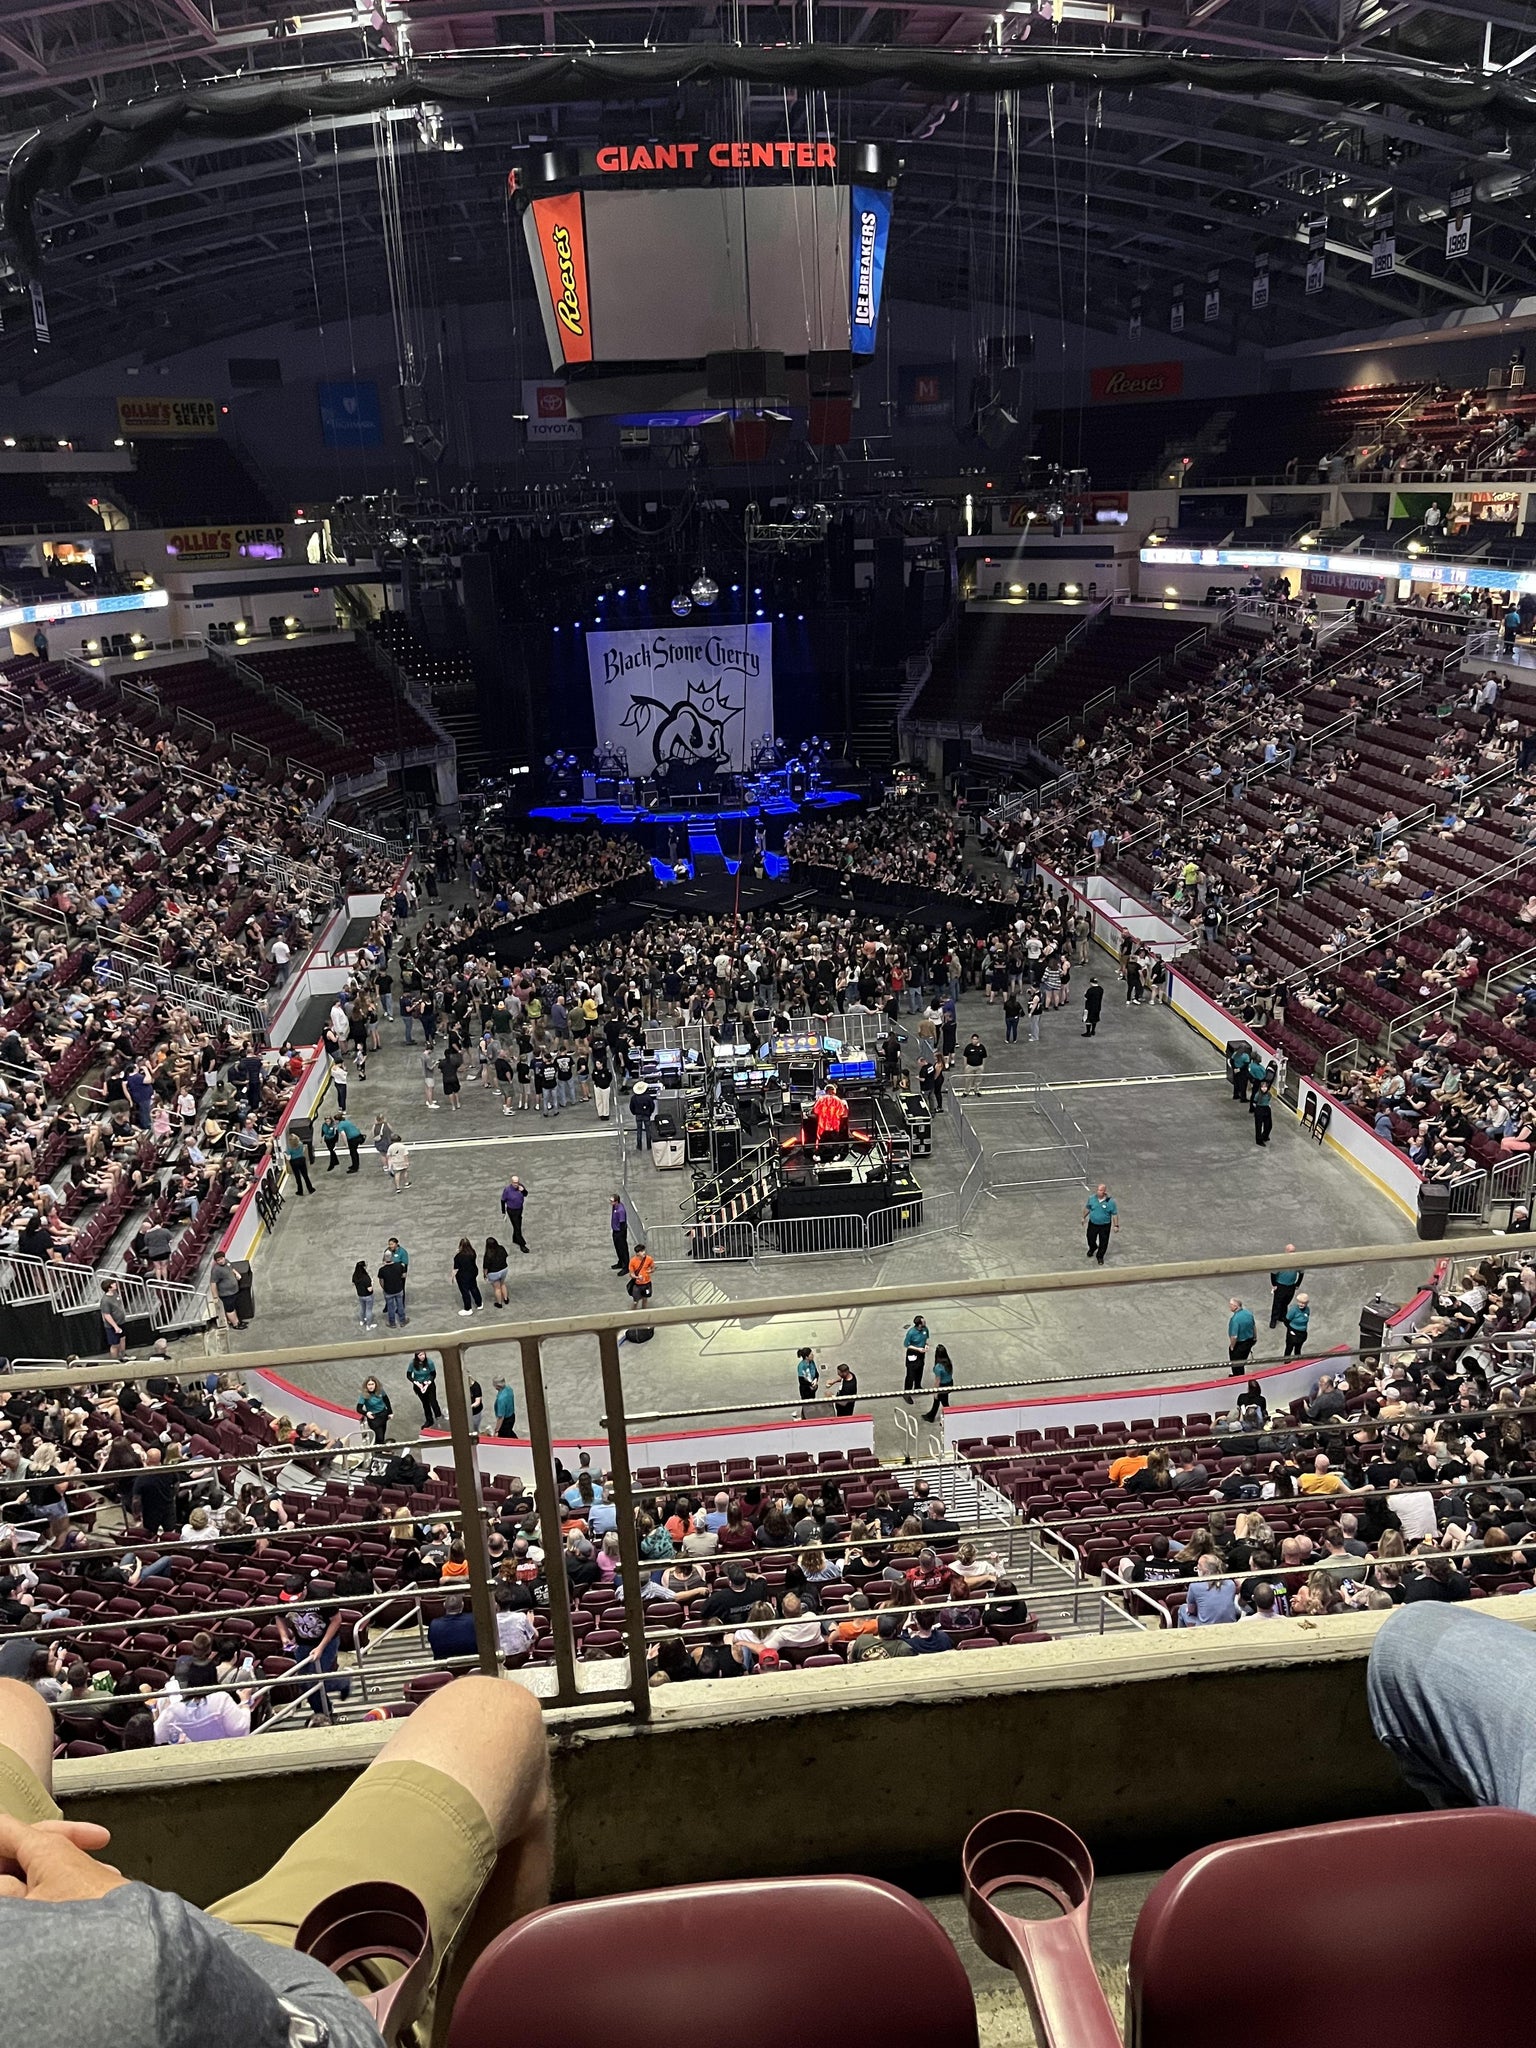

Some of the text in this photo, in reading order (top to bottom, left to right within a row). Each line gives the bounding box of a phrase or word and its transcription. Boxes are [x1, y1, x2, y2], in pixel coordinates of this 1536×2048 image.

[596, 142, 838, 172] GIANT CENTER
[1448, 232, 1468, 253] 1988
[855, 212, 877, 326] ICE BREAKERS
[1374, 253, 1393, 272] 1980
[552, 224, 584, 336] Reese's
[1105, 371, 1164, 394] Reese's
[173, 403, 214, 415] CHEAP
[176, 415, 215, 426] SEATS
[532, 423, 576, 434] TOYOTA
[170, 530, 231, 552] OLLIE'S
[235, 528, 284, 543] CHEAP
[1311, 573, 1374, 592] STELLA ARTOIS
[603, 635, 760, 685] Black Stone Cherry
